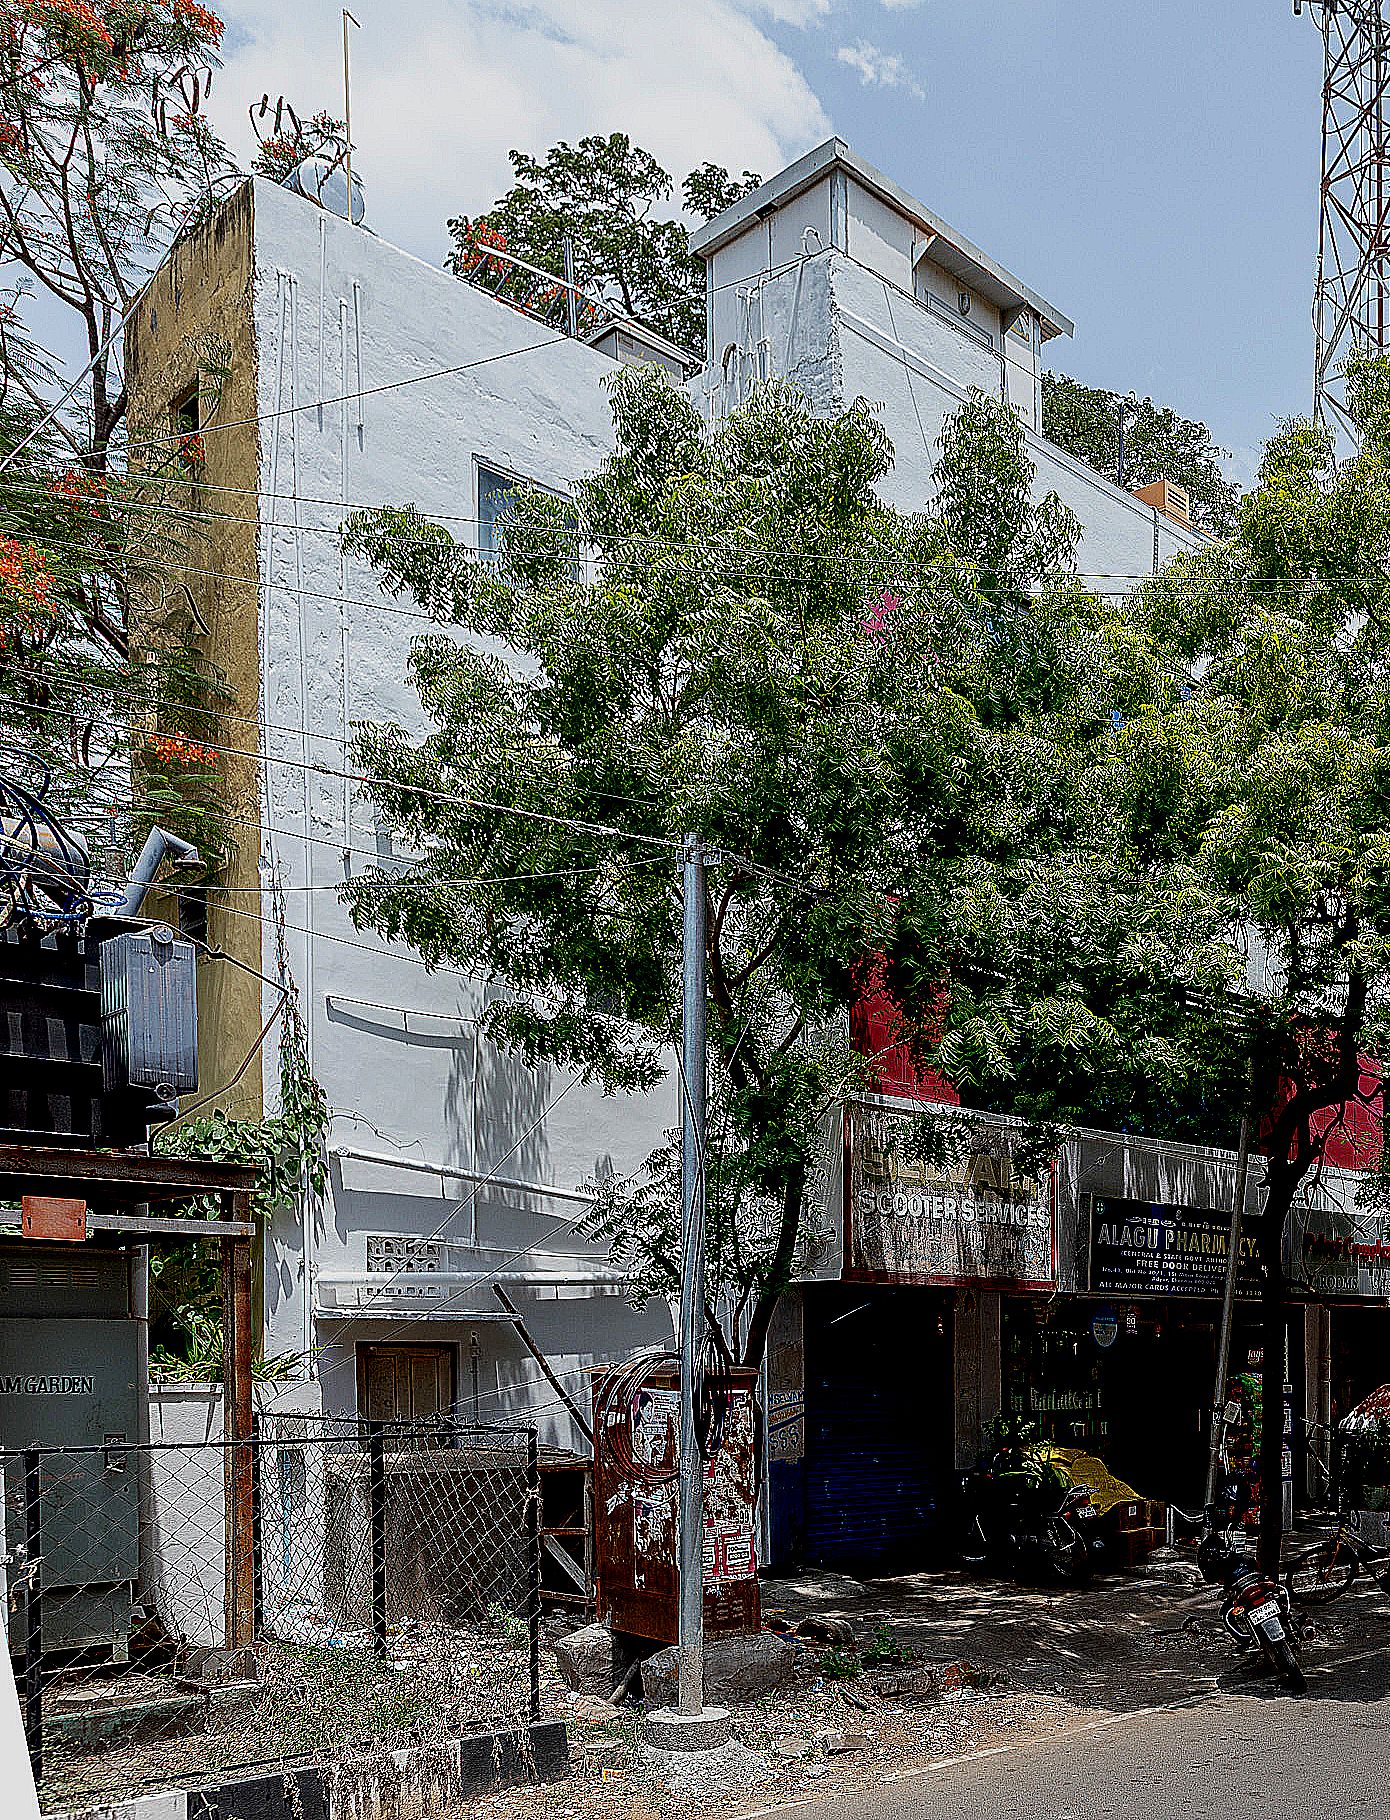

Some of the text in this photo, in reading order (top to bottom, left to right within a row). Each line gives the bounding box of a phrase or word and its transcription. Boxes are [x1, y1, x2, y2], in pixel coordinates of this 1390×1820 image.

[858, 1189, 1050, 1229] SCOOTER SERVICES
[1098, 1223, 1159, 1249] ALAGU
[1136, 1259, 1159, 1269] FREE
[1162, 1260, 1189, 1271] DOOR
[1114, 1282, 1143, 1290] MAJOR
[1144, 1283, 1169, 1292] CARDS
[1170, 1285, 1206, 1293] ACCEPTED
[24, 1375, 94, 1394] GARDEN
